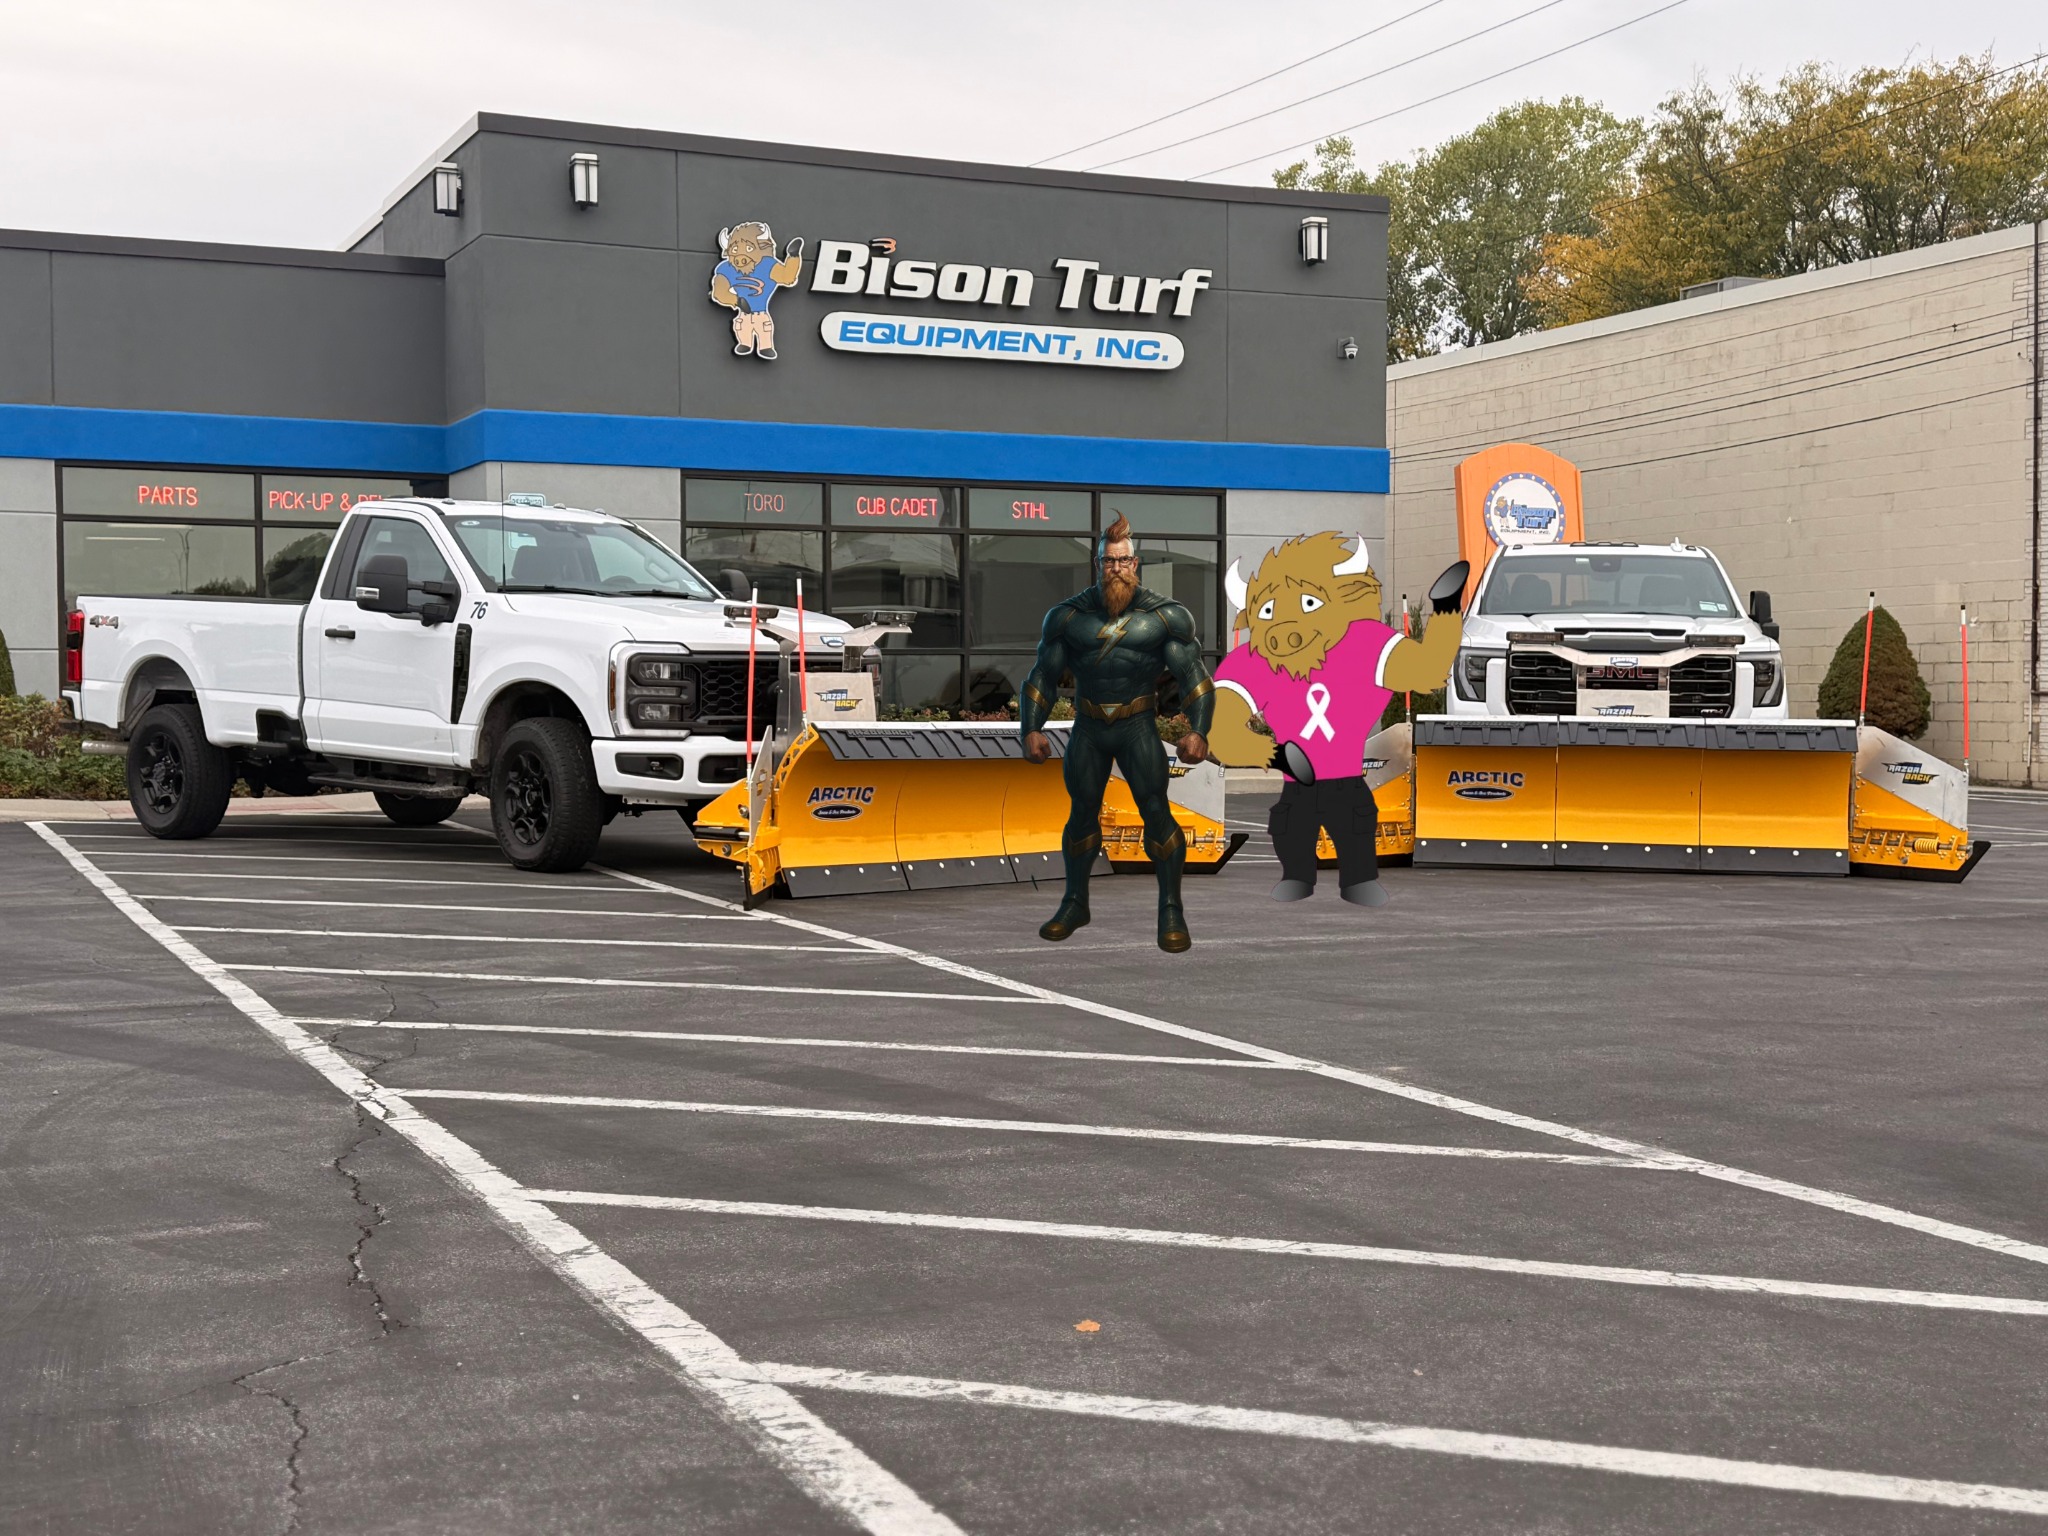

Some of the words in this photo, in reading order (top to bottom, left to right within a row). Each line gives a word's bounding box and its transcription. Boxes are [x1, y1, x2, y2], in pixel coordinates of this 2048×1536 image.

[810, 238, 1034, 307] Bison
[1054, 257, 1213, 317] Turf
[838, 319, 1082, 361] EQUIPMENT,
[1095, 337, 1169, 362] INC.
[138, 485, 198, 506] PARTS
[268, 490, 334, 511] PICK-UP
[339, 492, 352, 511] &
[743, 493, 785, 513] TORO
[856, 496, 886, 515] CUB
[889, 497, 938, 517] CADET
[1011, 500, 1050, 520] STIHL
[470, 601, 488, 620] 76
[1446, 770, 1524, 788] ARCTIC
[806, 786, 875, 805] ARCTIC
